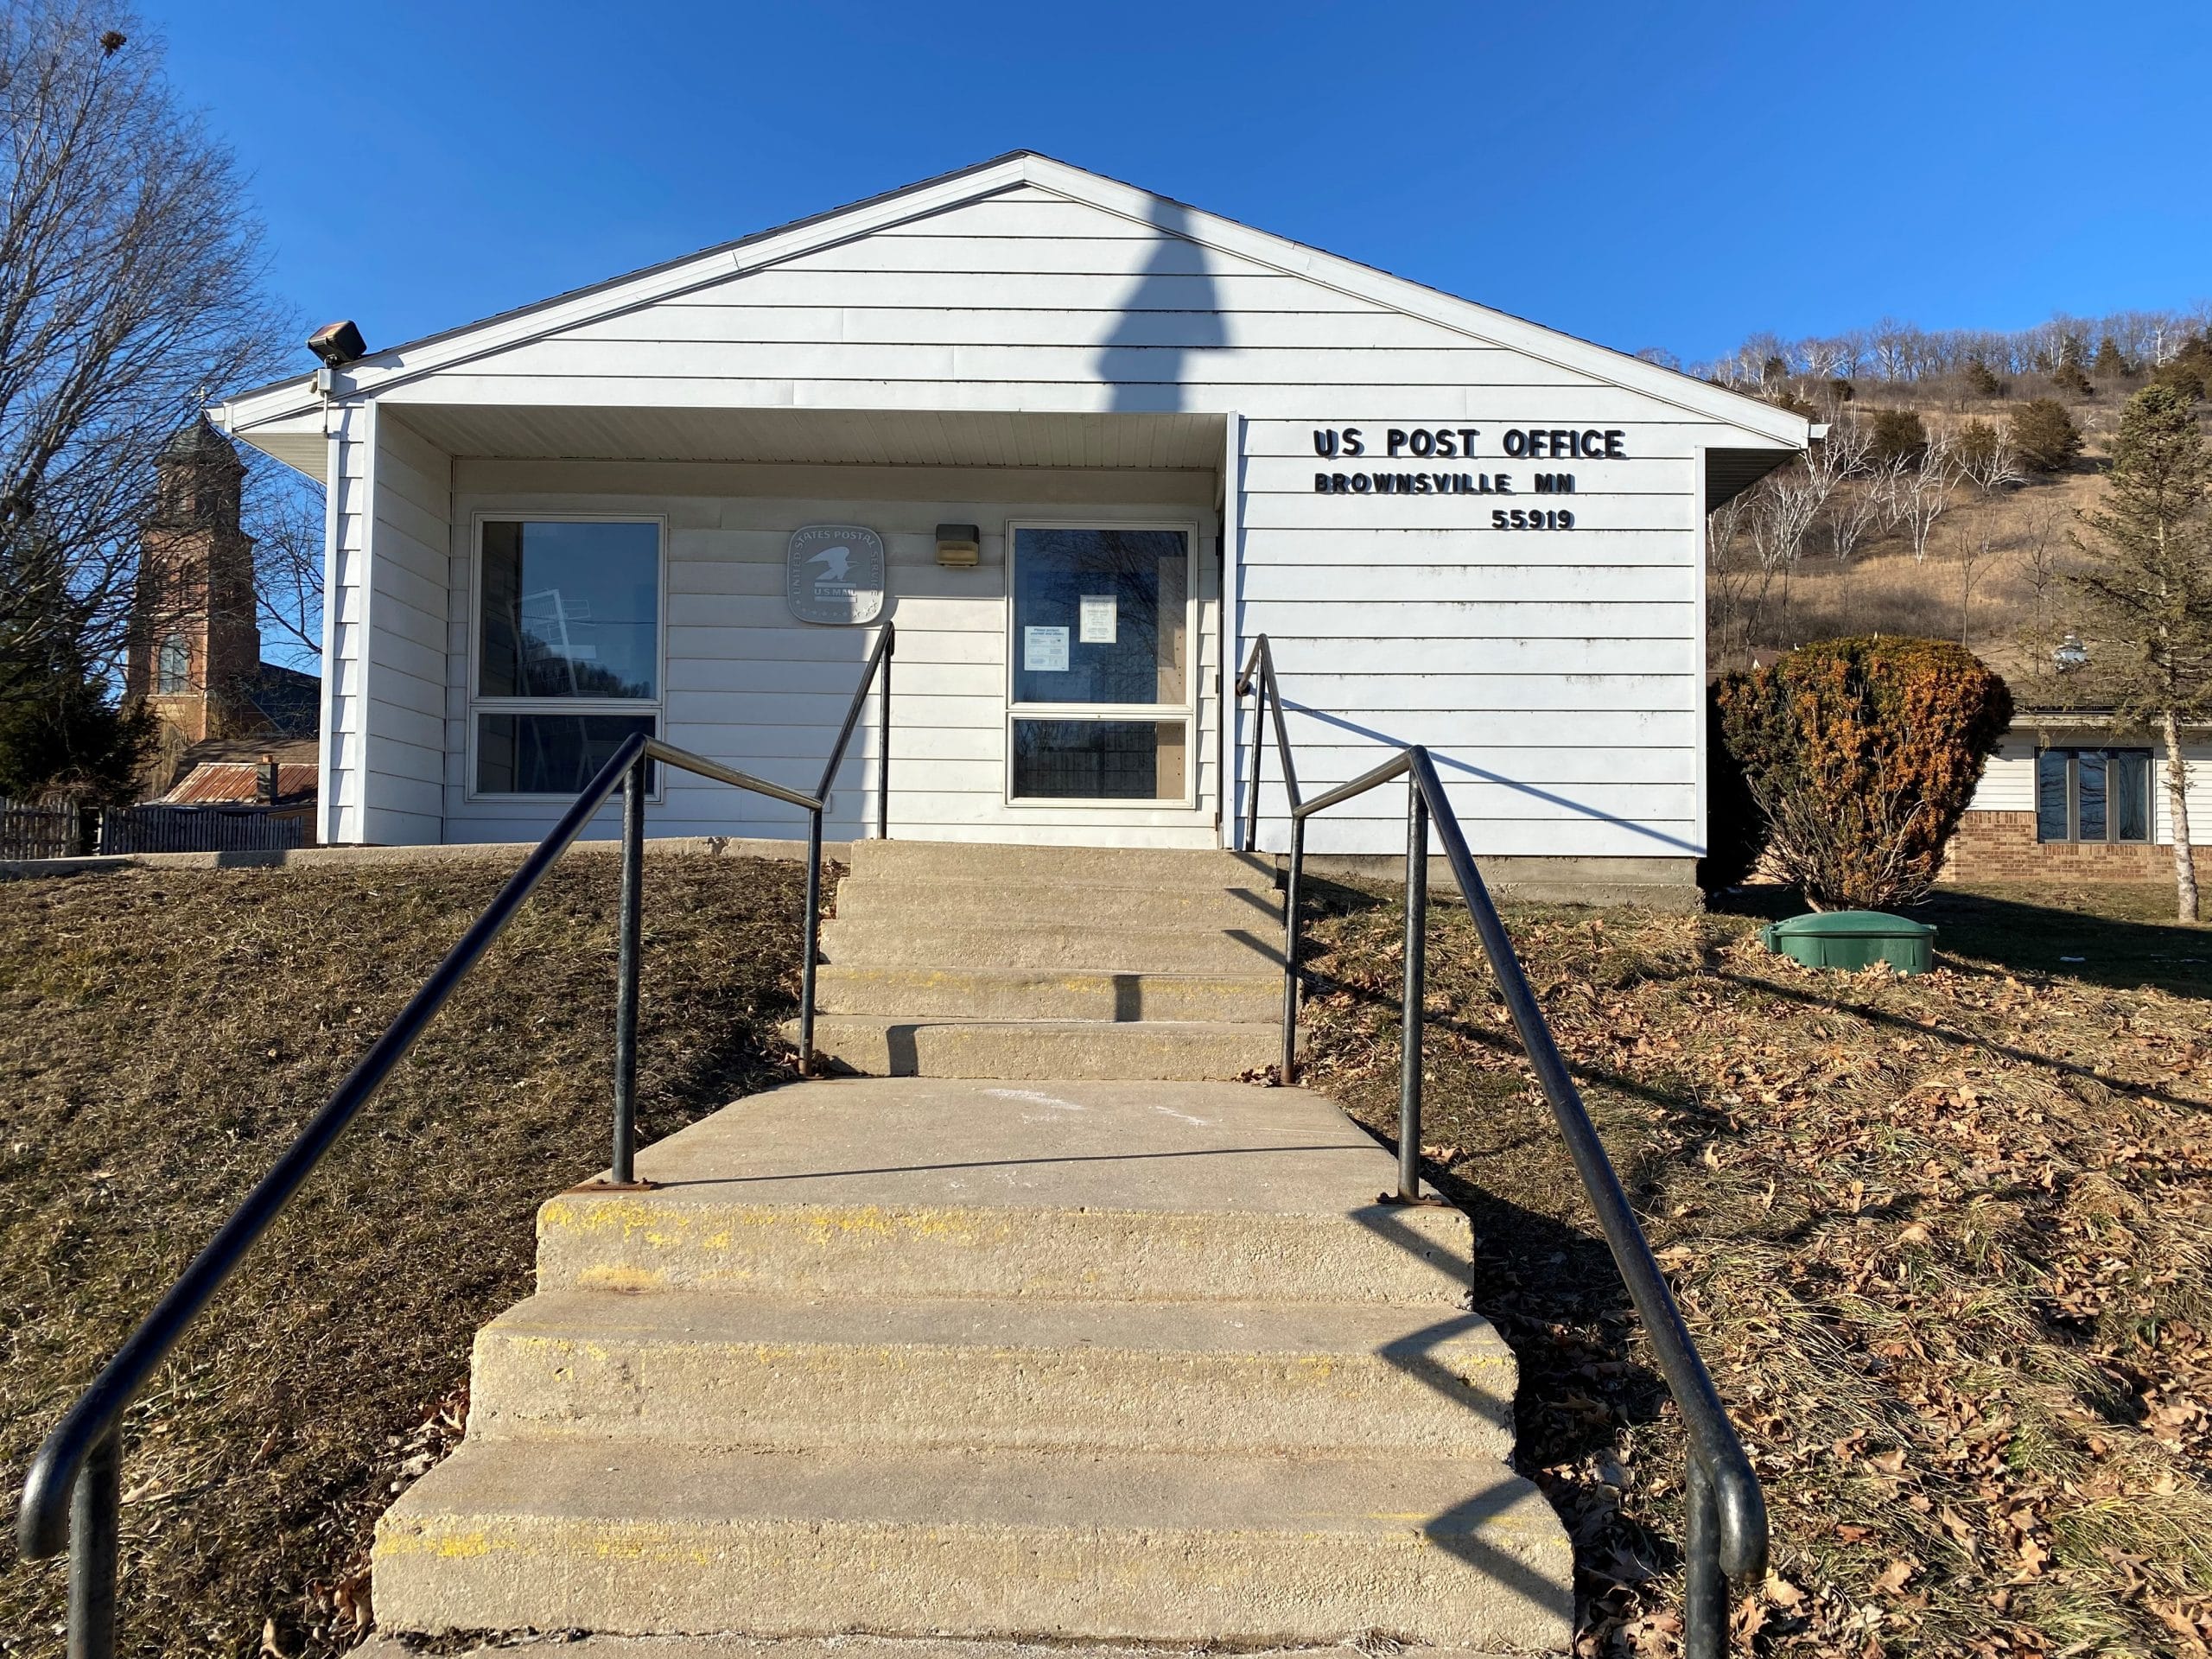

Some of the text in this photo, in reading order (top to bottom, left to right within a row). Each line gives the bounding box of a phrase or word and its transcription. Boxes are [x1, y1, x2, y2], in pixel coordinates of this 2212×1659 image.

[1313, 428, 1626, 458] US POST OFFICE
[1314, 473, 1575, 493] BROWNSVILLE MN
[1491, 509, 1574, 530] 55919
[792, 531, 879, 596] UNITED STATES POSTAL SERVICE
